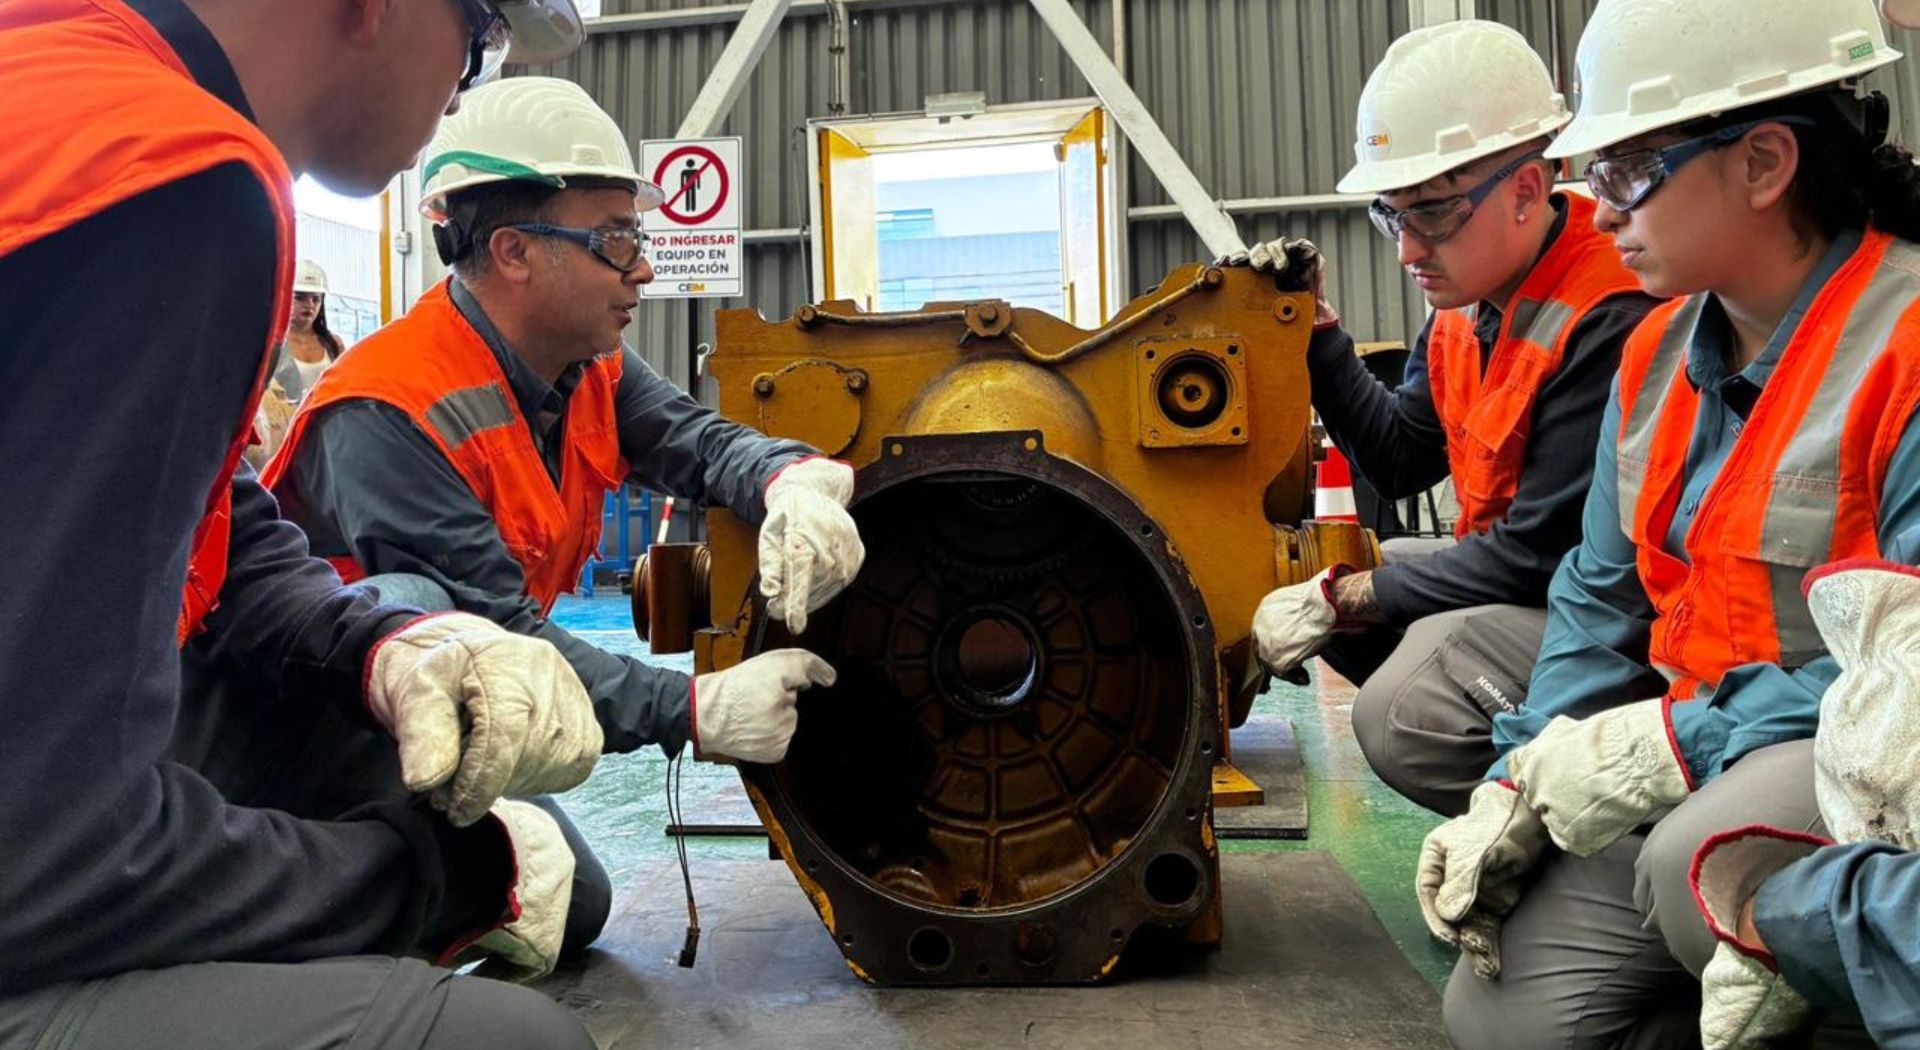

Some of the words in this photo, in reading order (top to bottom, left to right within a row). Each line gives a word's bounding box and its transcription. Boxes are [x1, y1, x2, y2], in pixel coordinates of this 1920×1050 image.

[670, 235, 735, 246] INGRESAR
[656, 250, 705, 260] EQUIPO
[708, 250, 726, 259] EN
[653, 261, 729, 275] OPERACIÓN
